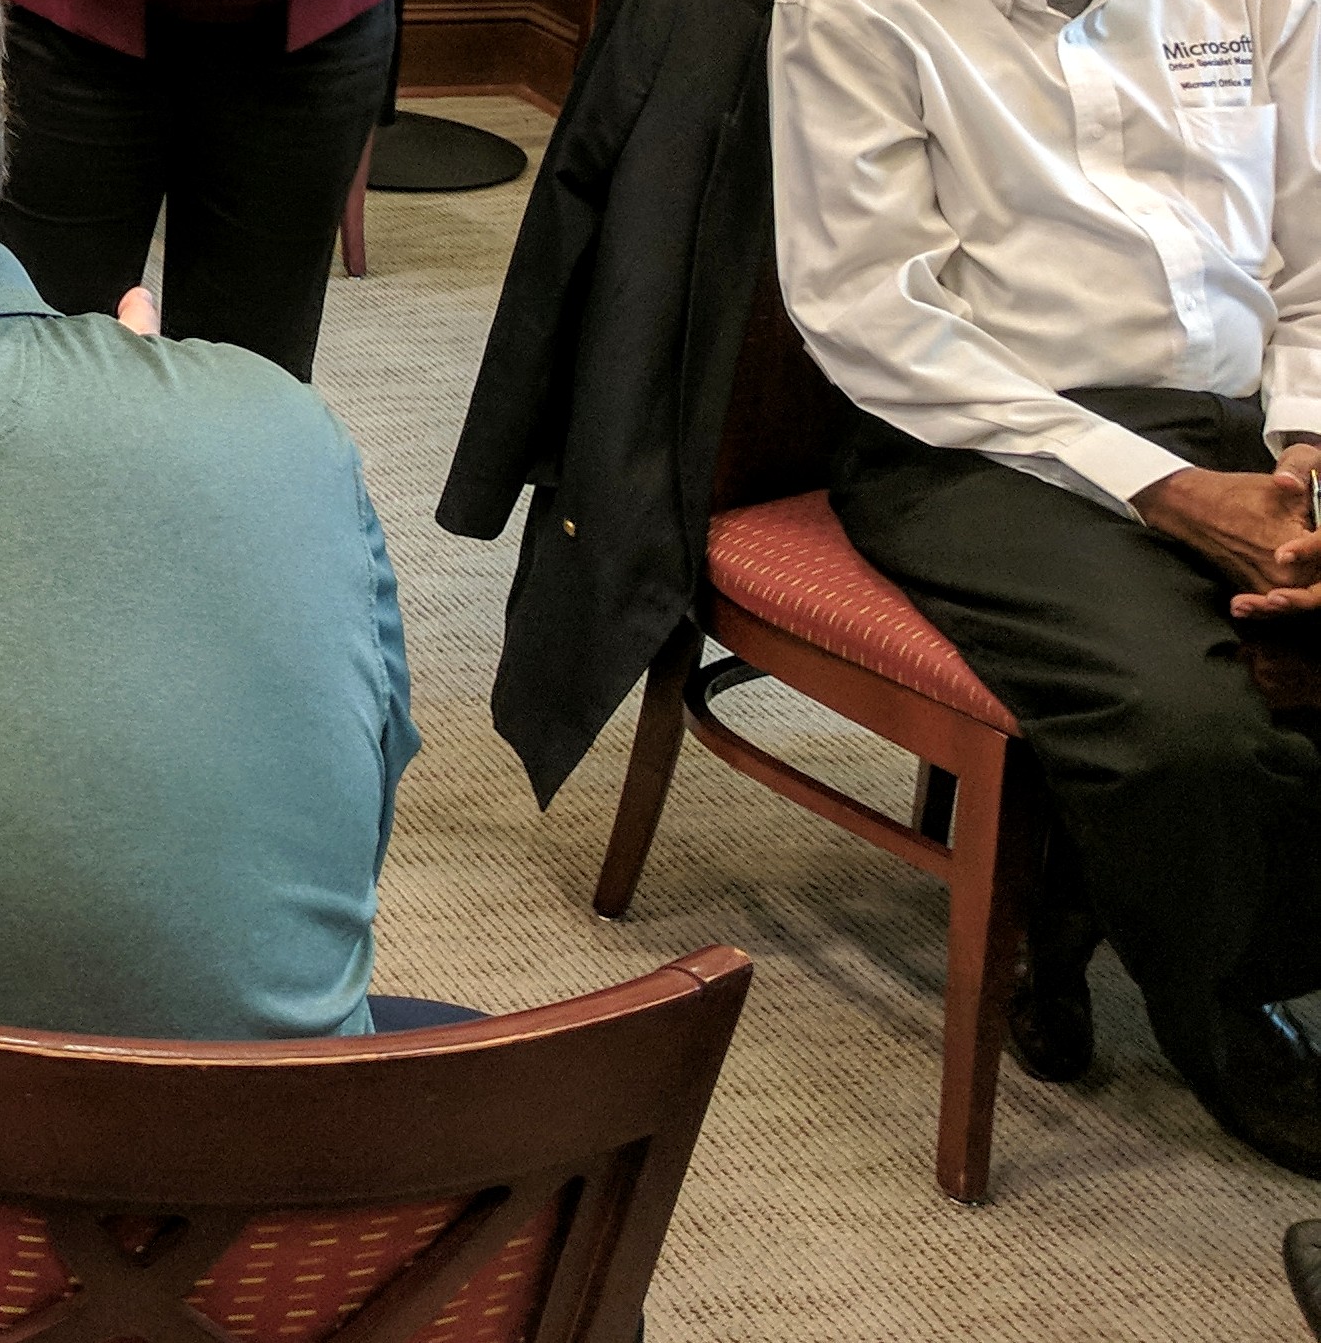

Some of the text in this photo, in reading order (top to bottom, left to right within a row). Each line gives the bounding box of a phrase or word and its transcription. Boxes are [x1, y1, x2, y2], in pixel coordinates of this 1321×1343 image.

[1162, 35, 1253, 60] Microsoft
[1168, 62, 1194, 71] Office
[1197, 57, 1232, 67] Specialist
[1218, 79, 1241, 87] Office
